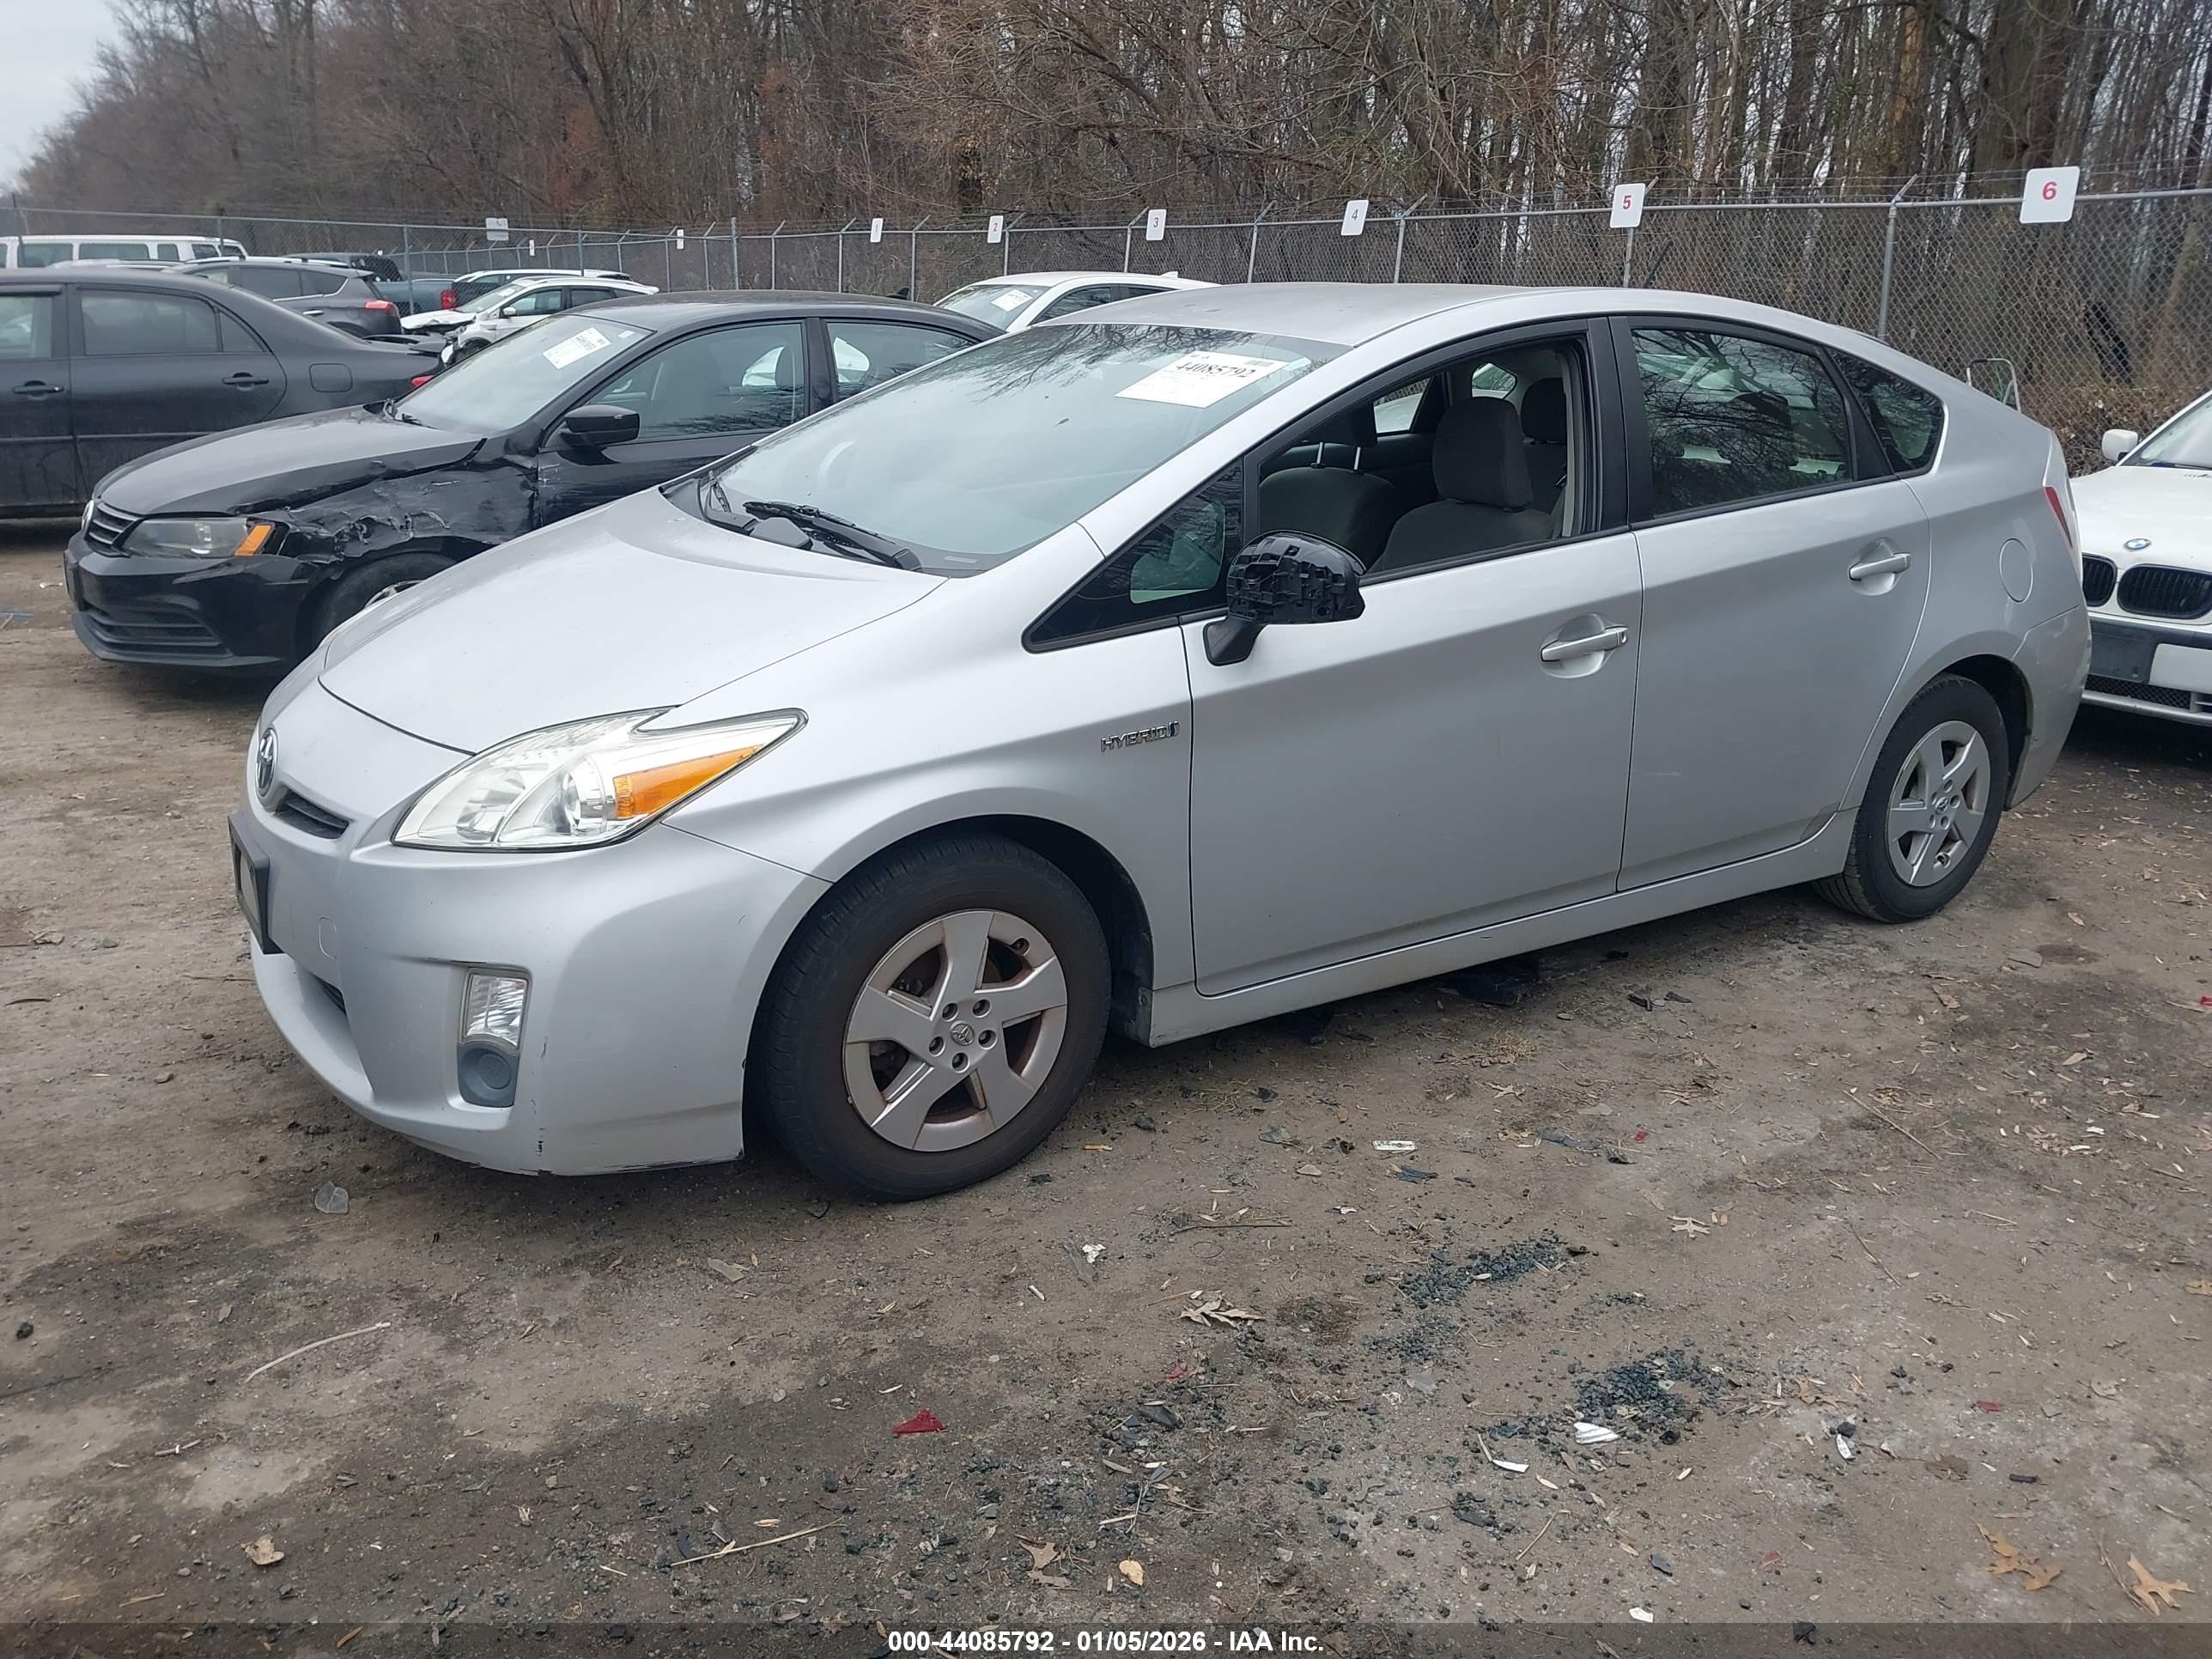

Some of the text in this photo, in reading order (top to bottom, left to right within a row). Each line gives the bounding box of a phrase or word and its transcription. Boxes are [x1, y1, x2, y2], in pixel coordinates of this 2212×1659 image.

[2042, 181, 2057, 200] 6
[1623, 194, 1632, 210] 5
[1153, 216, 1159, 228] 3
[1352, 208, 1358, 221] 4
[1176, 362, 1256, 379] 44085792
[1100, 726, 1168, 752] HYBRID
